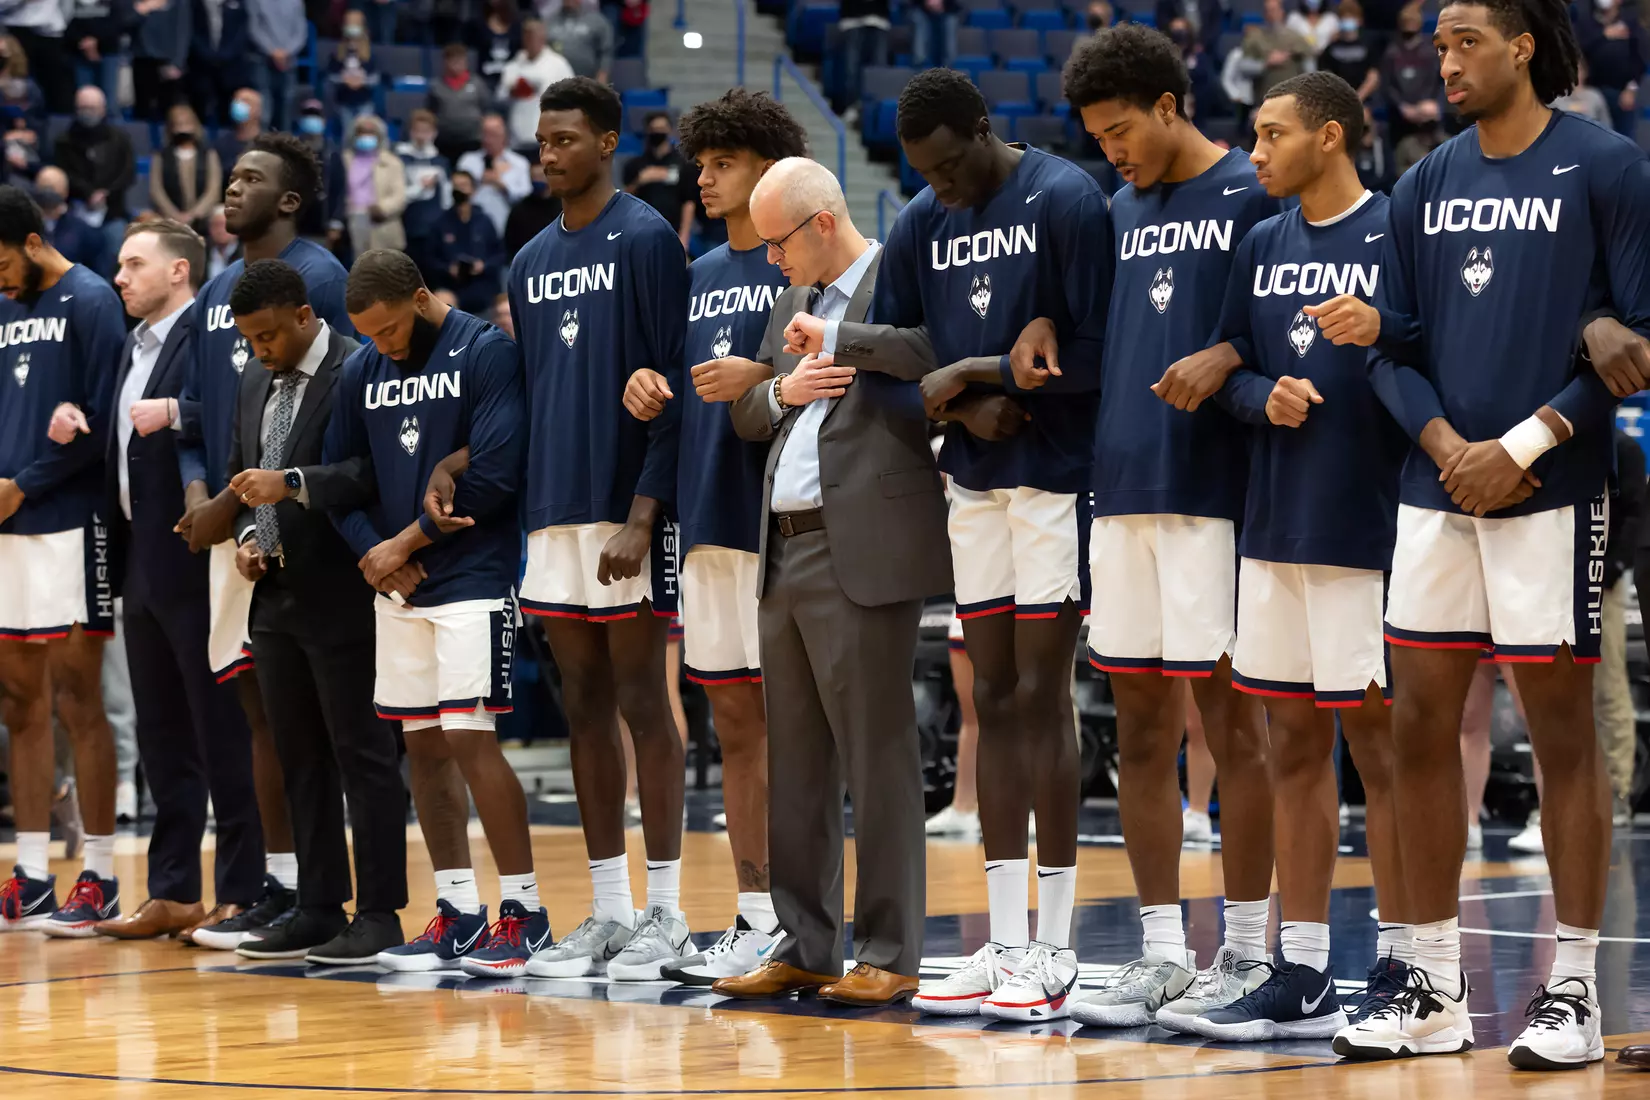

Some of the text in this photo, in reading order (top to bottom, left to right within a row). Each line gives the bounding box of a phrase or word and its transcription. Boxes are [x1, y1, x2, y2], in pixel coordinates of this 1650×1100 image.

[1424, 197, 1562, 235] UCONN
[931, 222, 1037, 271] UCONN
[1120, 219, 1234, 261] UCONN
[527, 262, 616, 304] UCONN
[1253, 262, 1380, 297] UCONN
[688, 285, 785, 322] UCONN
[0, 317, 67, 349] UCONN
[365, 370, 461, 410] UCONN
